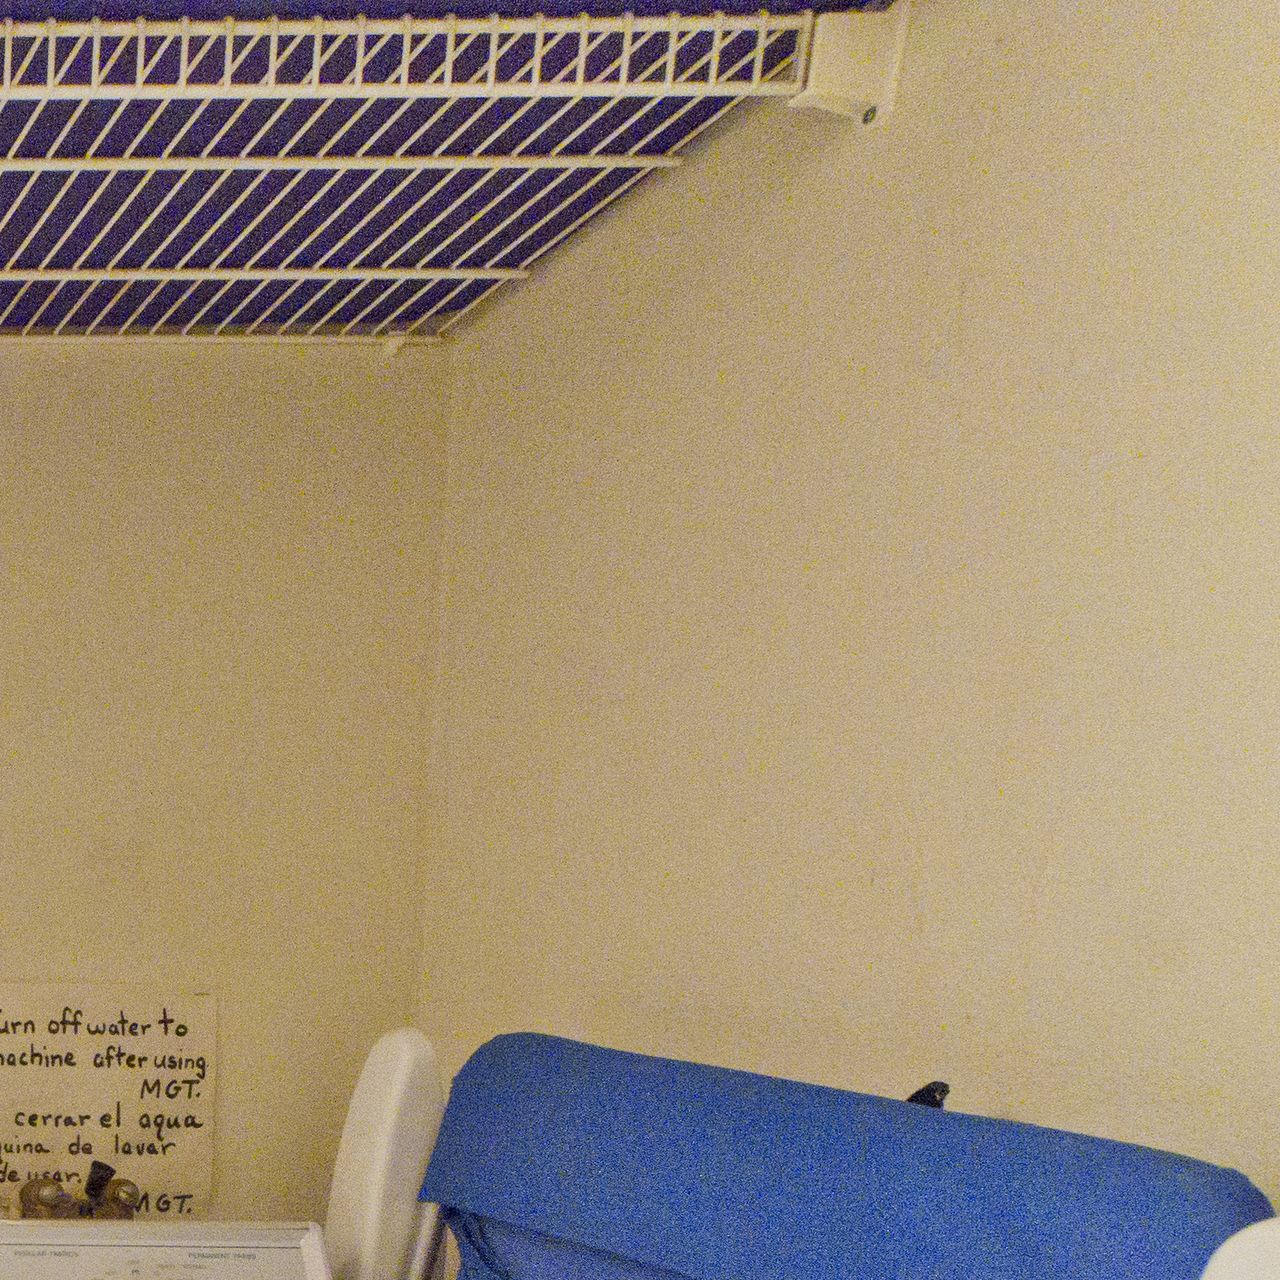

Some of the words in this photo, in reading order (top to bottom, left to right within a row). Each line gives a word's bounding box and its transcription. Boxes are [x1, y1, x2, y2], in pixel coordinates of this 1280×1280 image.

[48, 1006, 83, 1034] off
[87, 1010, 151, 1036] water
[158, 1008, 188, 1037] to
[93, 1045, 148, 1068] after
[140, 1079, 200, 1099] MGT.
[15, 1112, 90, 1127] cerrar
[100, 1101, 121, 1128] el
[68, 1134, 93, 1155] de
[115, 1133, 176, 1155] lavar
